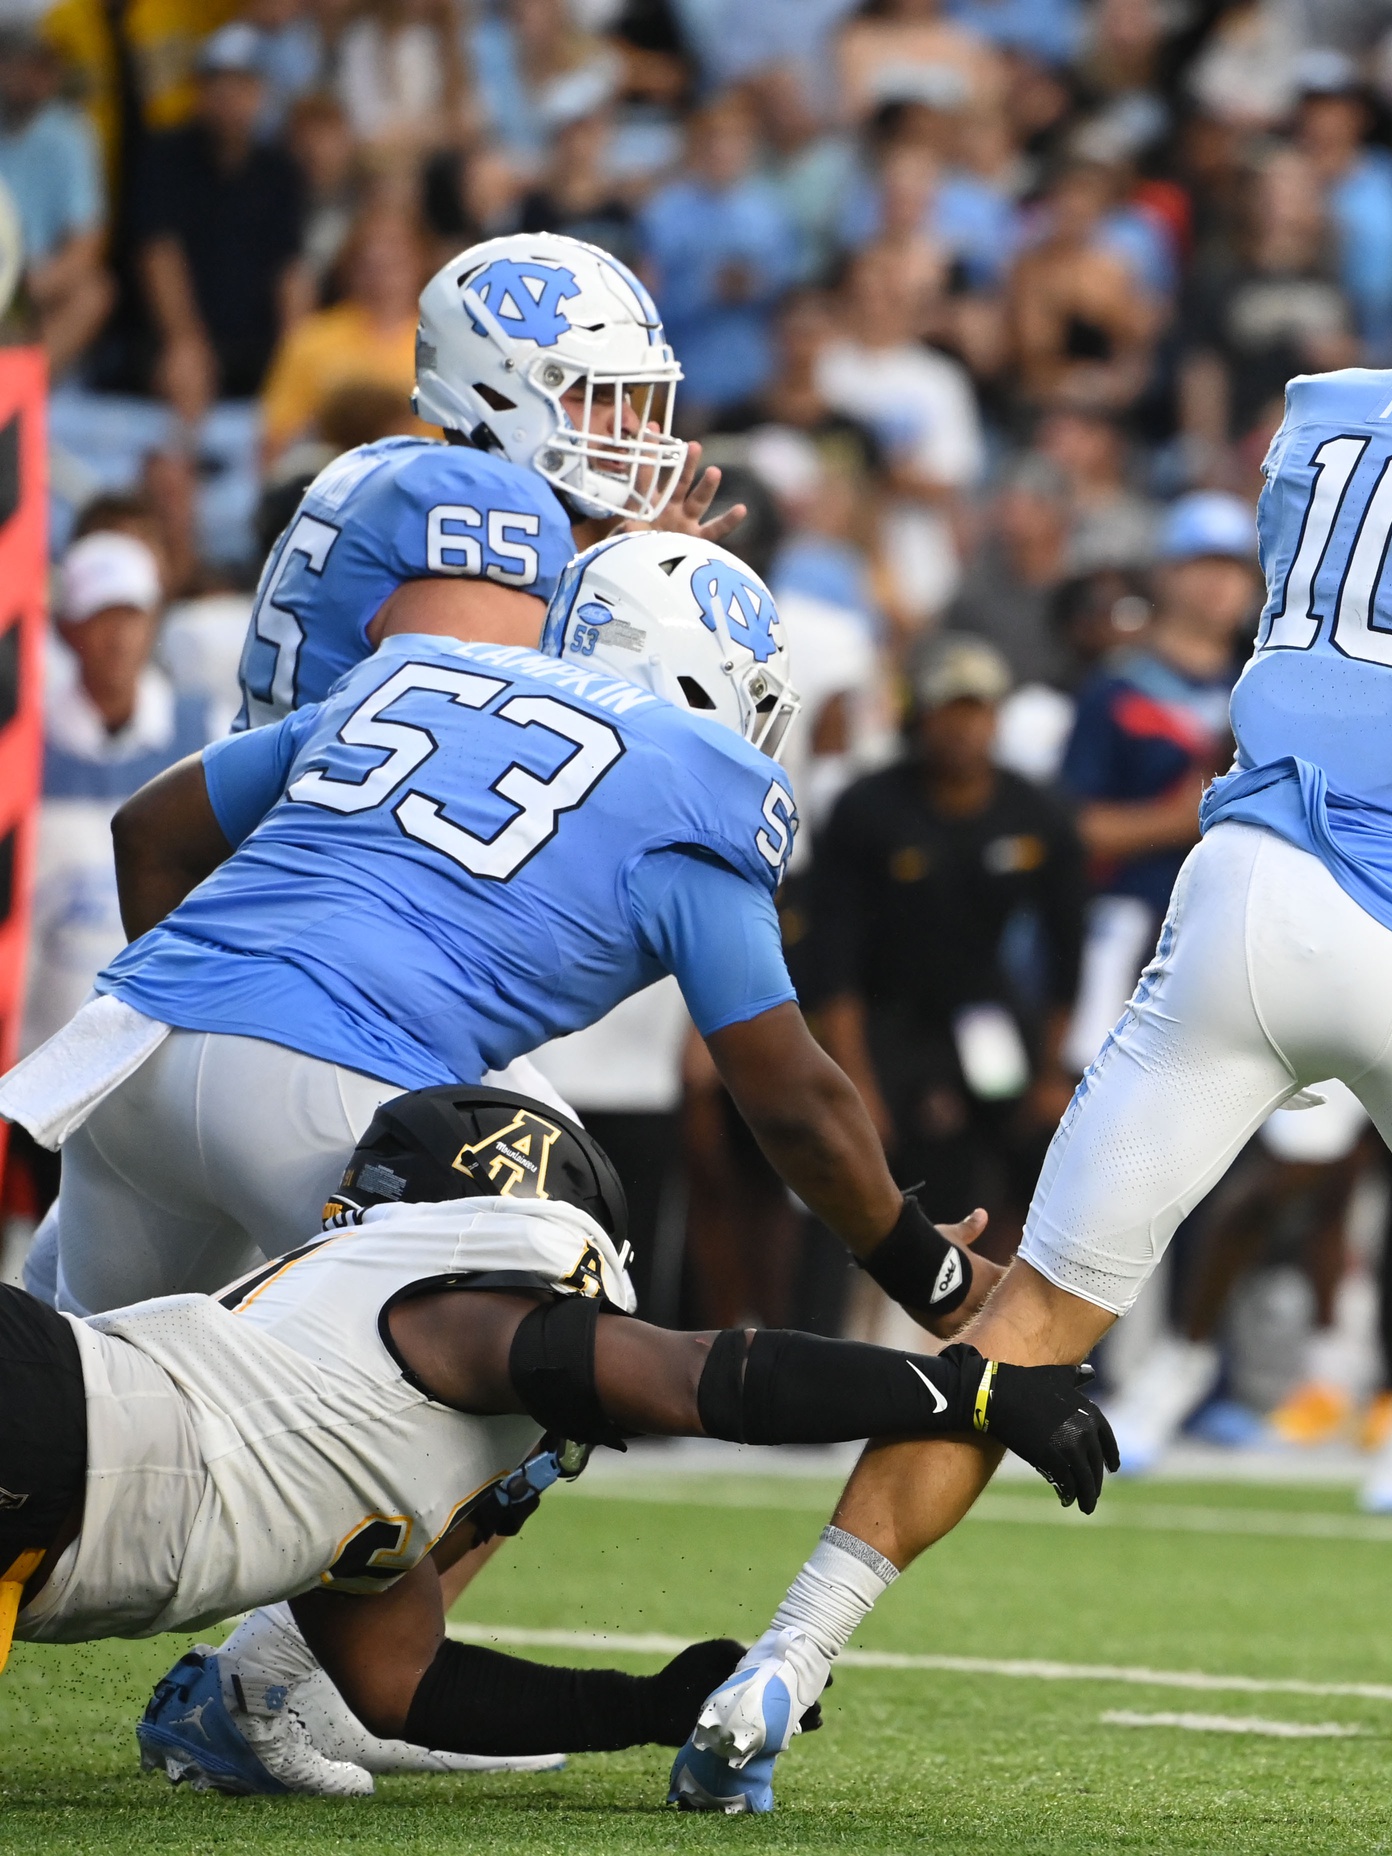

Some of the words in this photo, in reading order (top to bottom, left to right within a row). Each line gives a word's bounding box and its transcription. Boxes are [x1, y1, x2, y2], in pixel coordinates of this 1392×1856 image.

[427, 504, 541, 587] 65
[570, 624, 600, 656] 53
[454, 642, 658, 714] LAMPKIN
[287, 661, 627, 883] 53
[495, 1140, 538, 1174] Mountaineers
